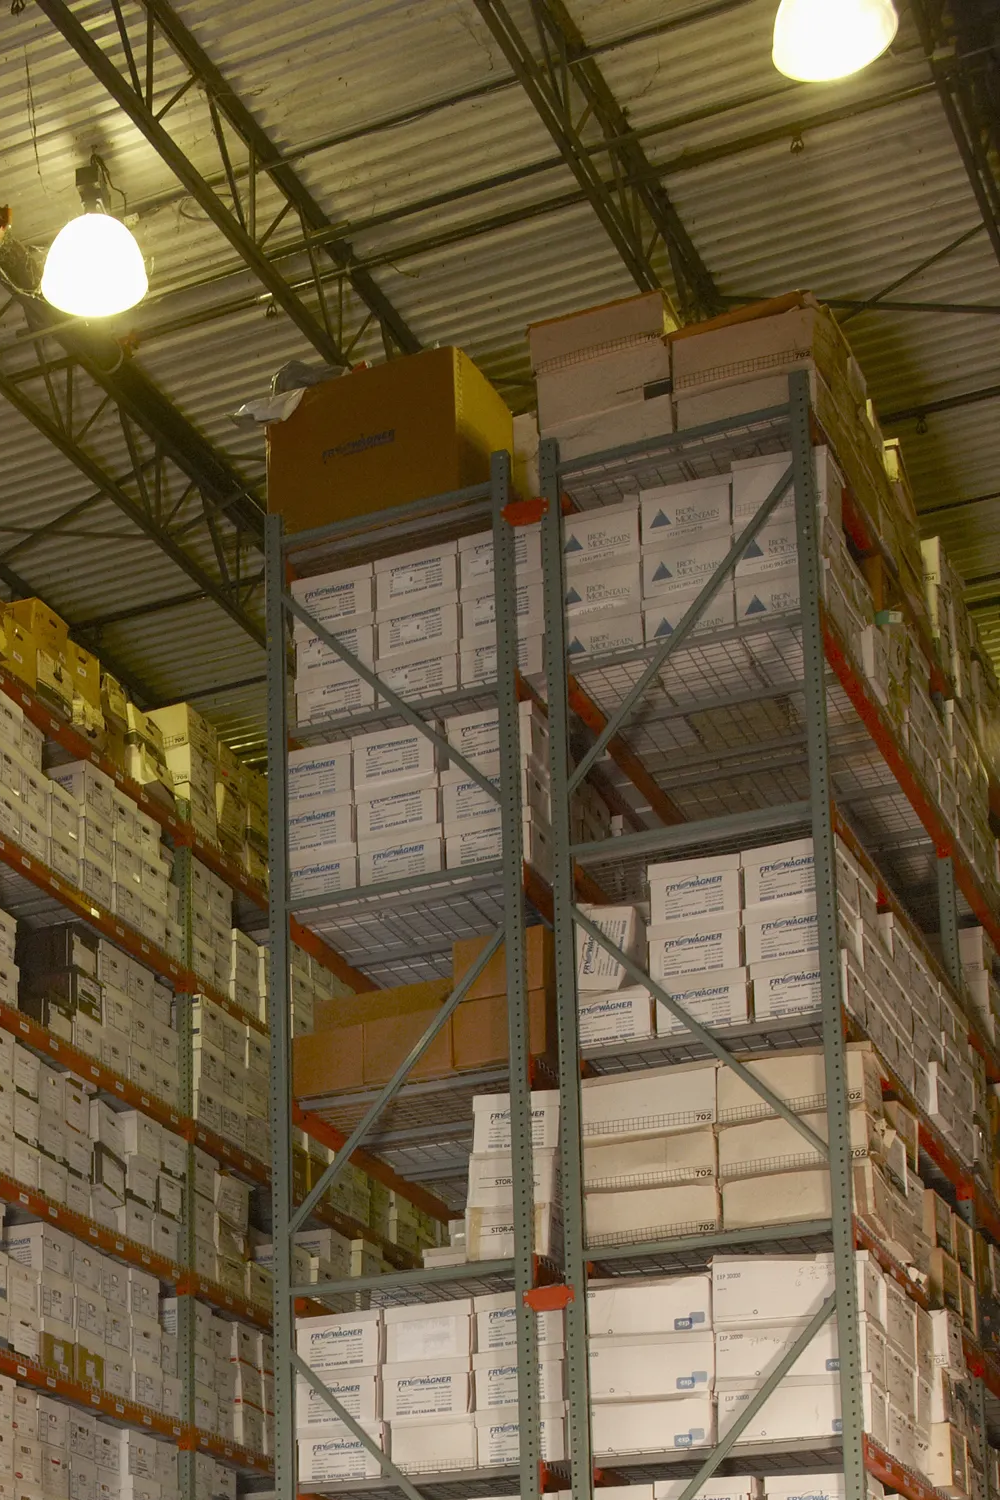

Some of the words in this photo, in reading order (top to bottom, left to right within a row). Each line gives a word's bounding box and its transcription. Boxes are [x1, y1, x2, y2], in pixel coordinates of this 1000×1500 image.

[675, 506, 695, 516] IRON
[675, 508, 720, 523] MOUNTAIN
[587, 531, 606, 540] IRON
[587, 533, 630, 548] MOUNTAIN
[769, 537, 788, 546] IRON
[676, 558, 696, 568] IRON
[586, 583, 605, 593] IRON
[586, 587, 630, 600] MOUNTAIN
[771, 592, 790, 602] IRON
[590, 633, 609, 643] IRON
[393, 844, 424, 855] WAGNER
[759, 865, 775, 874] FRY
[665, 883, 680, 892] FRY
[688, 875, 723, 888] WAGNER
[761, 922, 776, 931] FRY
[664, 940, 679, 948] FRY
[687, 932, 722, 944] WAGNER
[769, 977, 785, 986] FRY
[694, 986, 729, 998] WAGNER
[600, 1000, 632, 1012] WAGNER
[695, 1113, 712, 1122] 702
[695, 1168, 713, 1178] 702
[698, 1223, 715, 1232] 702
